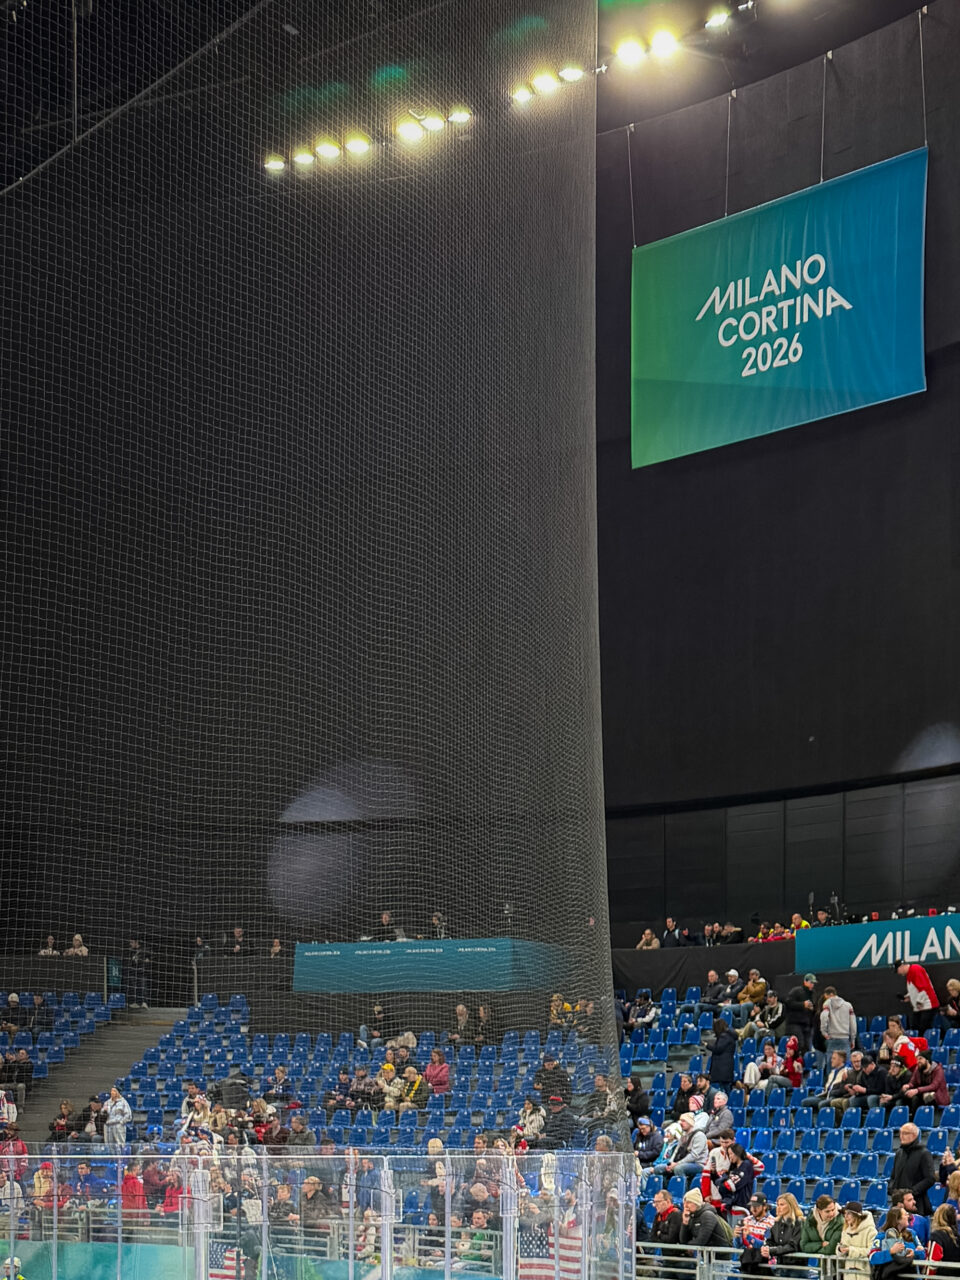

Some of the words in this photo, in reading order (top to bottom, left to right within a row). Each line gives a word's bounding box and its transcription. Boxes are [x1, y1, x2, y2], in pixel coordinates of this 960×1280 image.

[695, 253, 826, 321] MILANO
[717, 286, 853, 347] CORTINA
[741, 333, 803, 378] 2026
